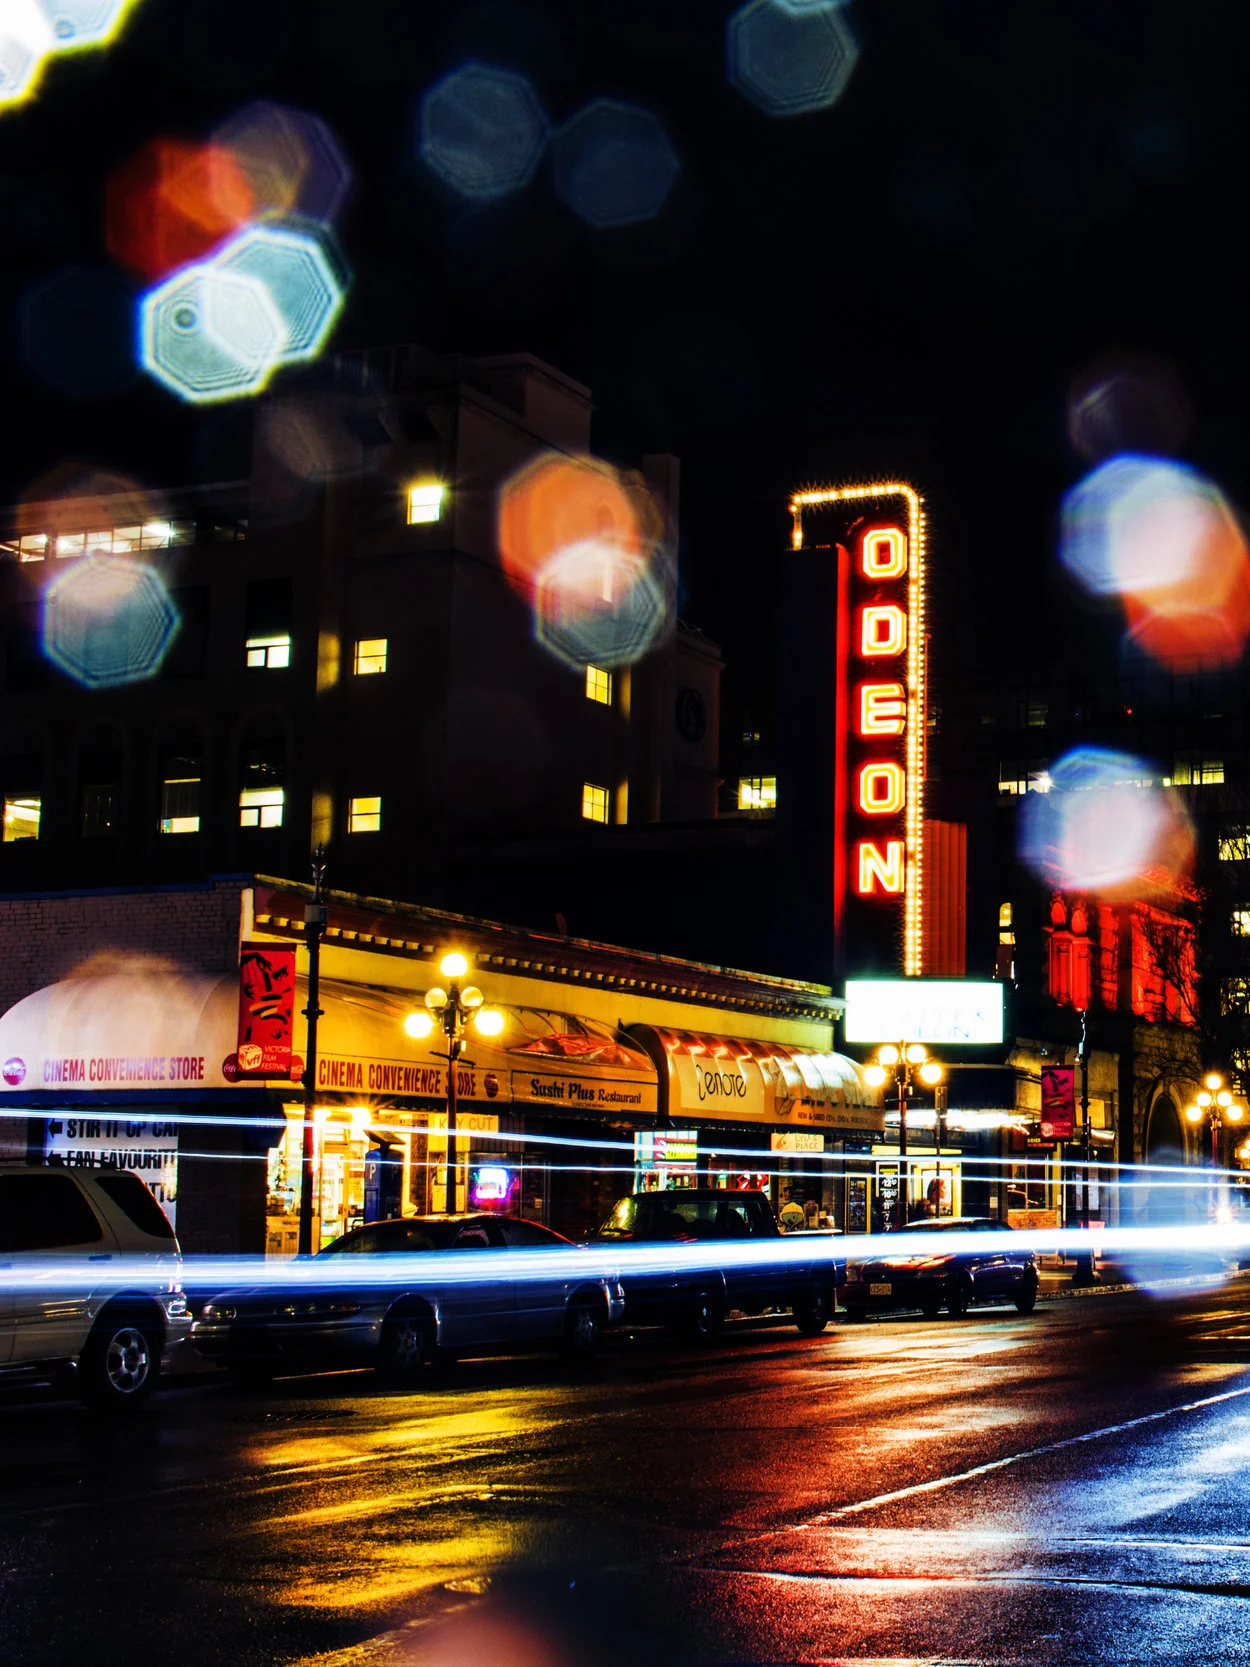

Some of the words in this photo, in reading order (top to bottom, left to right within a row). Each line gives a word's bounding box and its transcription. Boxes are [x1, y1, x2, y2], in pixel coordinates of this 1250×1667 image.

[859, 528, 907, 893] ODEON
[263, 1054, 276, 1062] FILM
[264, 1045, 291, 1053] VICTORIA
[43, 1058, 85, 1082] CINEMA
[89, 1057, 165, 1081] CONVENIENCE
[169, 1057, 205, 1080] STORE
[261, 1062, 287, 1072] FESTIVAL
[319, 1059, 363, 1088] CINEMA
[368, 1064, 441, 1093] CONVENIENCE
[530, 1078, 565, 1098] Sushi
[568, 1083, 595, 1101] Plus
[598, 1089, 641, 1104] Restaurant
[67, 1119, 100, 1138] STIR
[440, 1118, 463, 1130] KY
[469, 1118, 493, 1131] CUT
